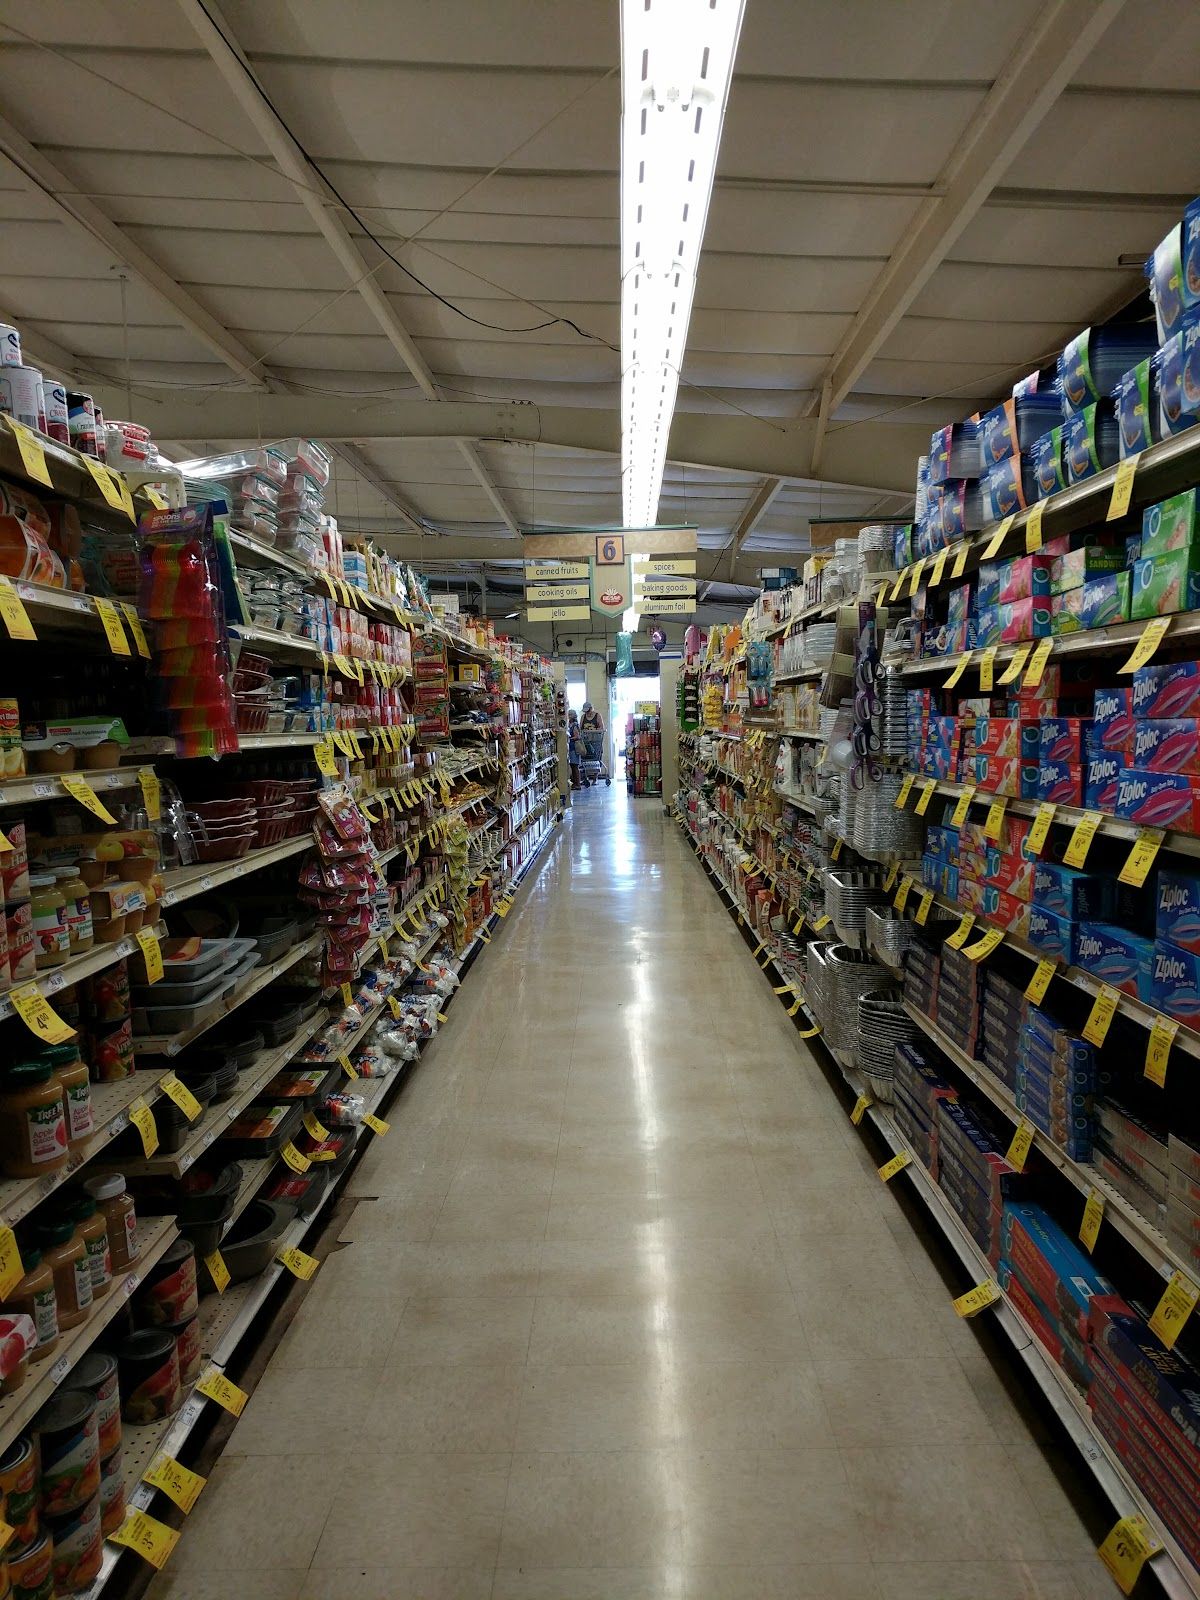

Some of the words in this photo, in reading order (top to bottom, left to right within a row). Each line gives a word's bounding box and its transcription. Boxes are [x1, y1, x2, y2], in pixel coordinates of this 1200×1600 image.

[602, 540, 615, 560] 6
[535, 567, 559, 576] canned
[561, 566, 579, 575] fruits
[654, 563, 675, 572] spices
[537, 588, 565, 598] cooking
[566, 587, 578, 596] oils
[641, 584, 664, 593] baking
[665, 583, 688, 593] goods
[551, 608, 566, 619] jello
[644, 602, 673, 611] aluminum
[674, 602, 686, 611] foil
[1133, 677, 1158, 706] Ziploc
[1095, 697, 1119, 723] Ziploc
[1136, 729, 1159, 756] Ziploc
[1089, 758, 1117, 784] Ziploc
[1118, 782, 1147, 807] Ziploc
[1160, 884, 1188, 912] Ziploc
[1079, 935, 1103, 958] Ziploc
[1155, 955, 1186, 982] Ziploc
